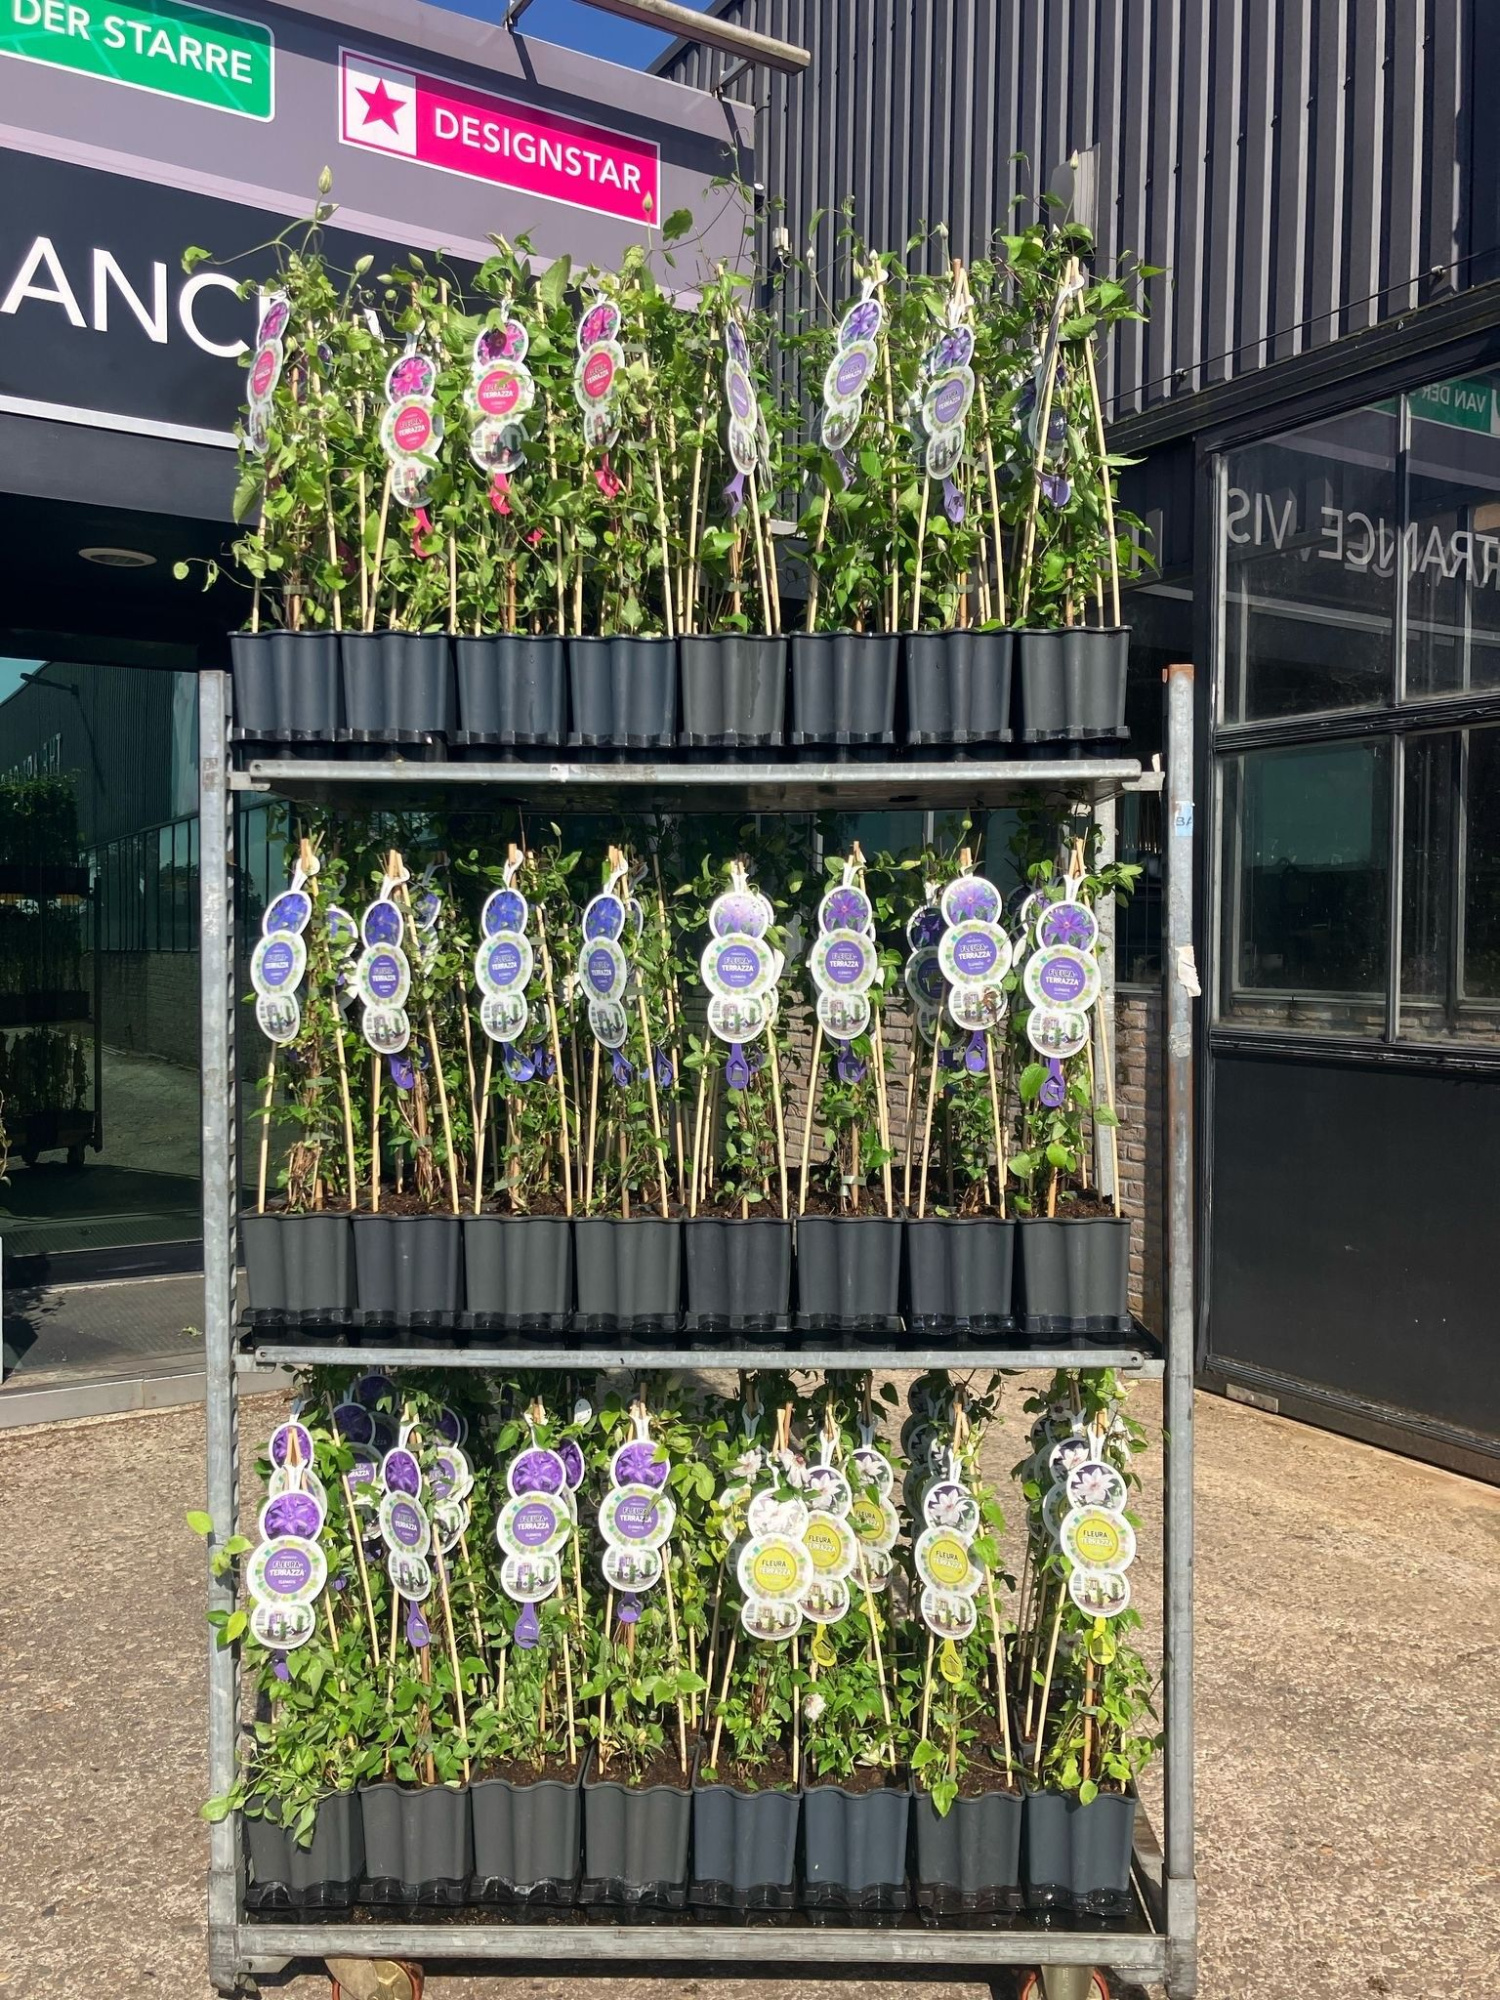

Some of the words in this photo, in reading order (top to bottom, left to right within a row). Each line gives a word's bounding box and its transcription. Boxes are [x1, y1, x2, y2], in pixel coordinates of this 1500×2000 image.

[12, 0, 91, 41] DER
[102, 15, 254, 85] STARRE
[433, 107, 642, 195] DESIGNSTAR
[482, 391, 514, 399] TERRAZZA
[398, 424, 426, 437] TERRAZZA
[958, 951, 991, 960] TERRAZZA
[492, 962, 517, 971] TERRAZZA
[722, 964, 753, 973] TERRAZZA
[830, 960, 858, 968] TERRAZZA
[1049, 969, 1074, 978] FLEURA
[1046, 976, 1079, 986] TERRAZZA
[620, 1515, 652, 1524] TERRAZZA
[395, 1520, 418, 1532] TERRAZZA
[518, 1522, 549, 1531] TERRAZZA
[1083, 1529, 1108, 1538] FLEURA
[809, 1535, 831, 1544] FLEURA
[1081, 1537, 1113, 1547] TERRAZZA
[936, 1551, 958, 1561] FLEURA
[270, 1568, 304, 1577] TERRAZZA
